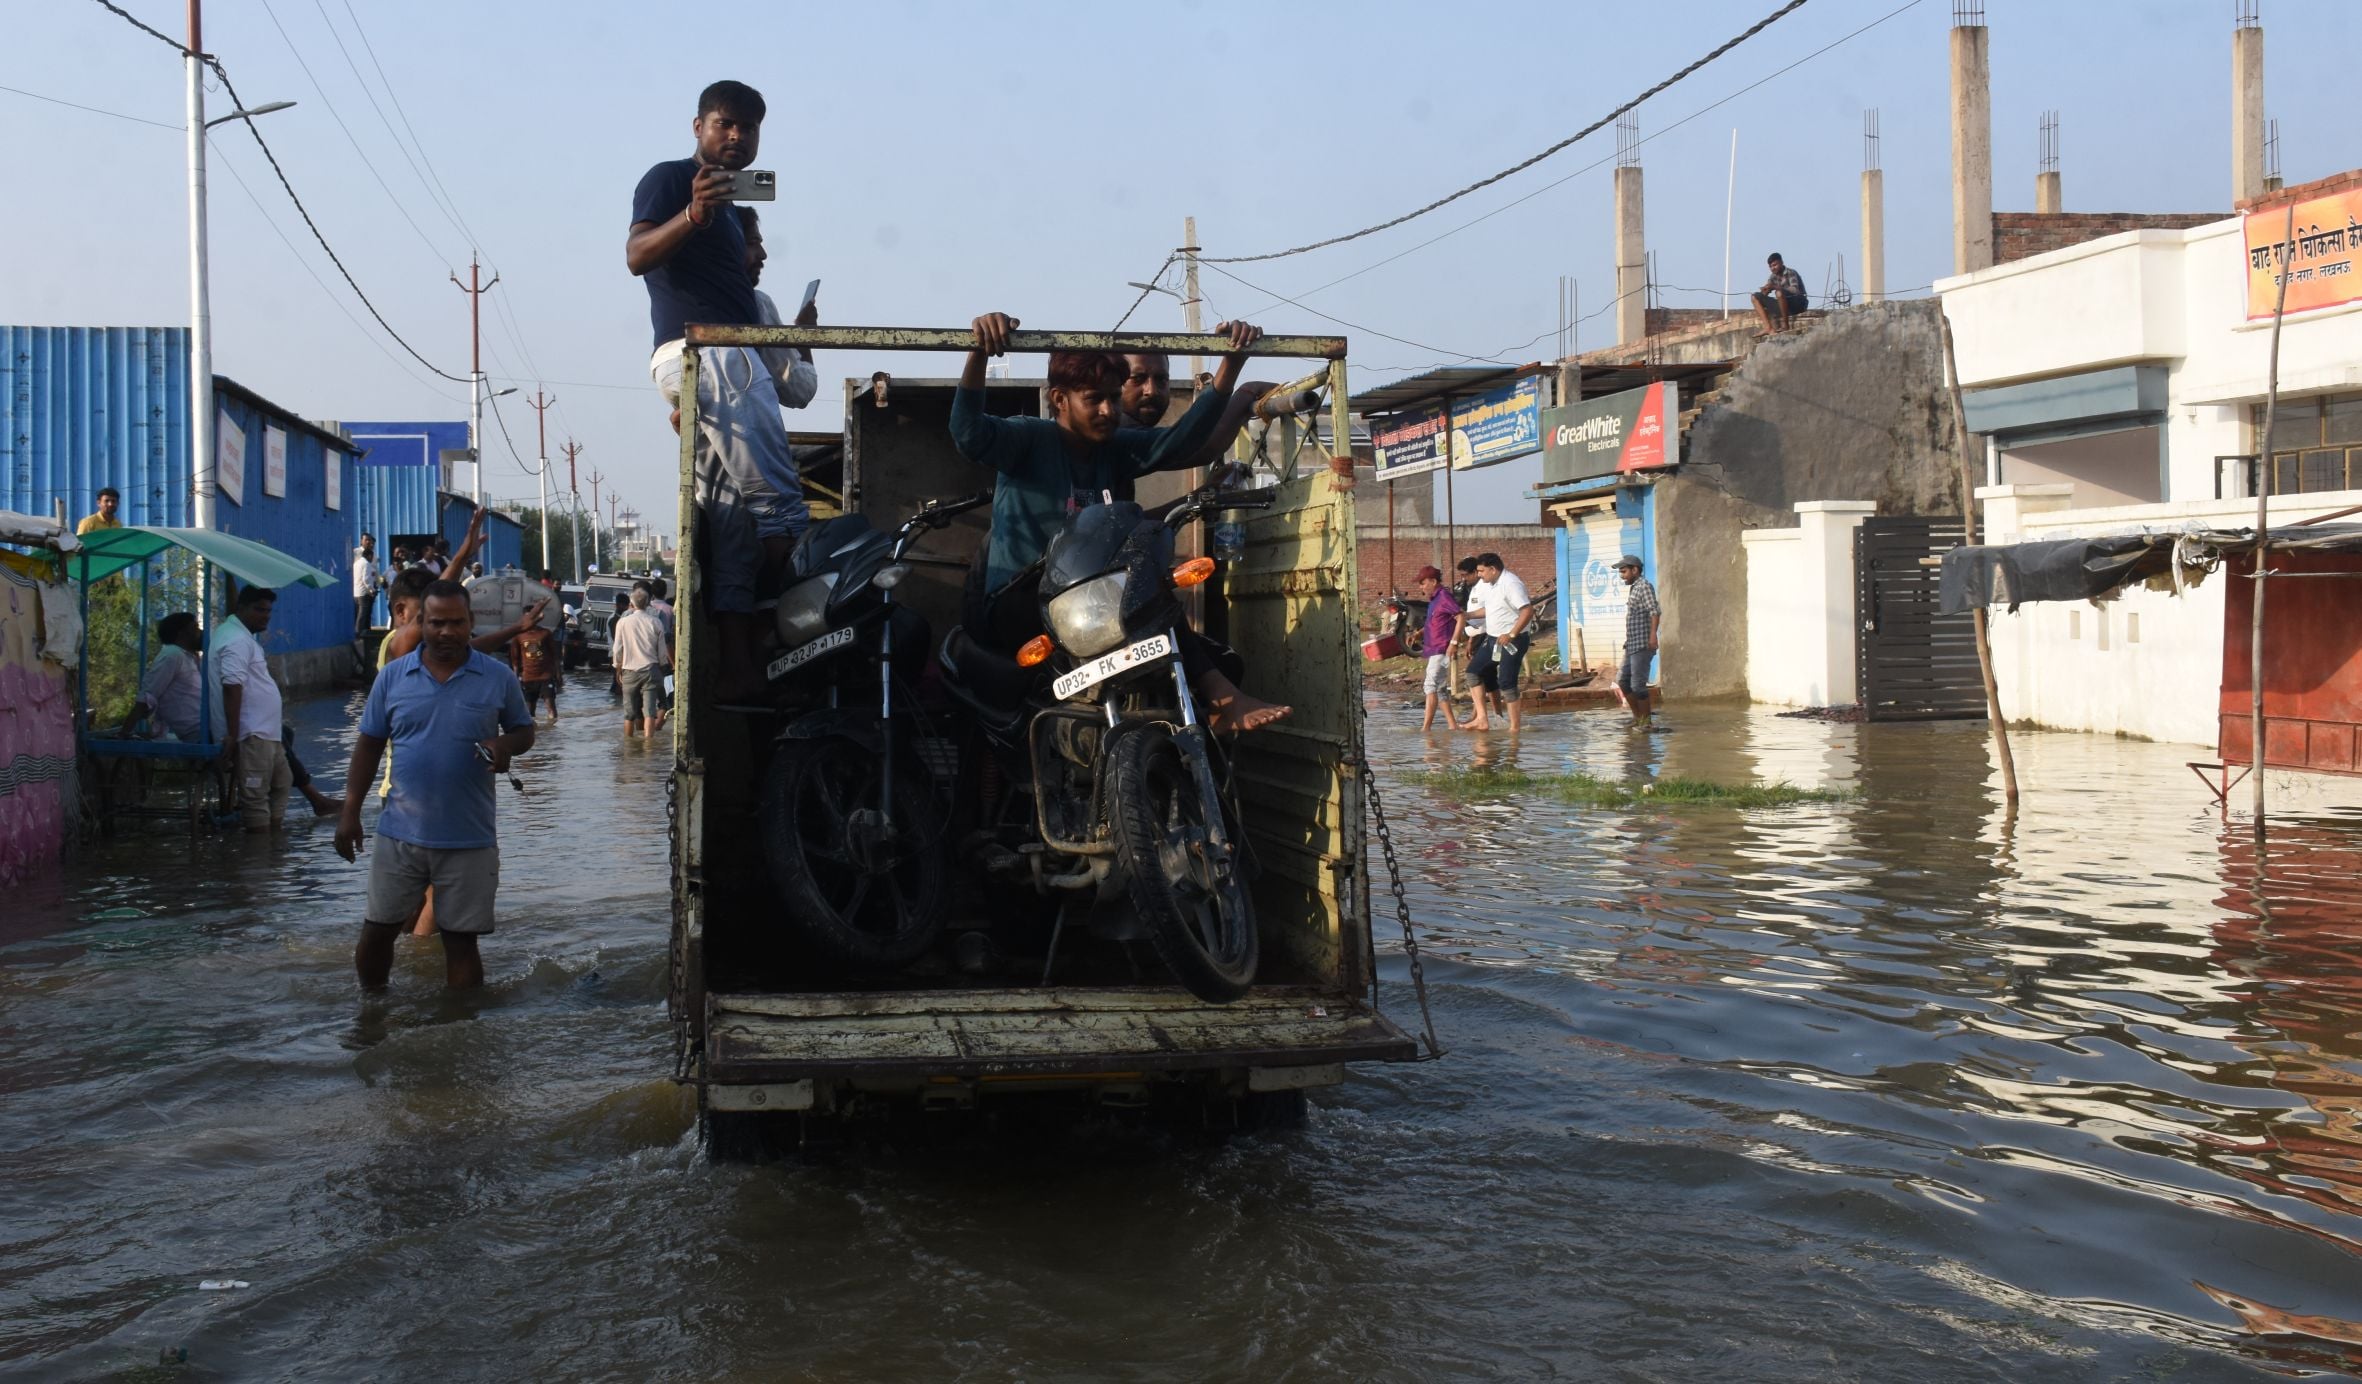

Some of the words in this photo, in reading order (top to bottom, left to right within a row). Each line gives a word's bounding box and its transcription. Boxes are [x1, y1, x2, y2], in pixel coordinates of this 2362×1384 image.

[2251, 246, 2271, 274] बाढ़
[2273, 239, 2296, 265] रात
[2298, 224, 2345, 260] चिकित्सा
[2319, 260, 2351, 277] लखनऊ
[1557, 415, 1620, 445] GreatWhite
[1588, 438, 1619, 452] Electricals
[1587, 565, 1607, 593] Gyan
[1098, 657, 1116, 675] FK
[1132, 640, 1164, 661] 3655
